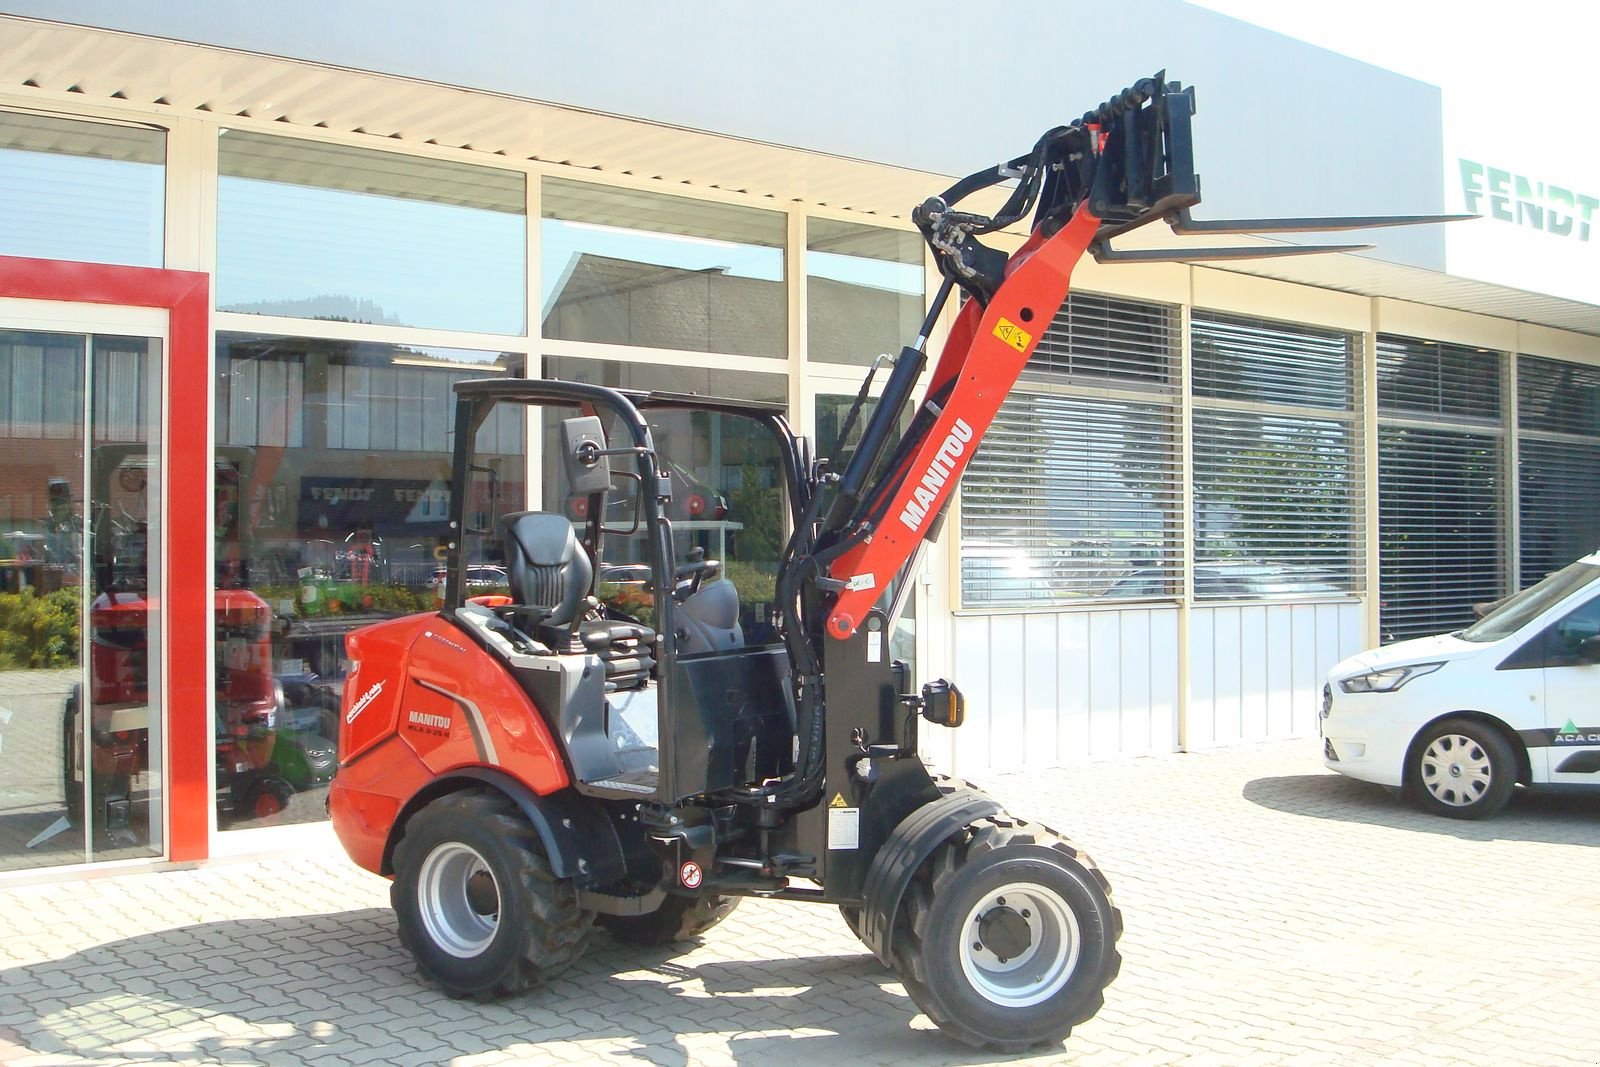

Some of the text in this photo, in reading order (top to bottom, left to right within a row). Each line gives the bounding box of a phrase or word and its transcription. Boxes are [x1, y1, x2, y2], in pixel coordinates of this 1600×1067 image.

[1457, 158, 1600, 242] FENDT
[899, 417, 973, 532] MANITOU
[409, 711, 451, 729] MANITOU
[1554, 734, 1585, 742] ACA
